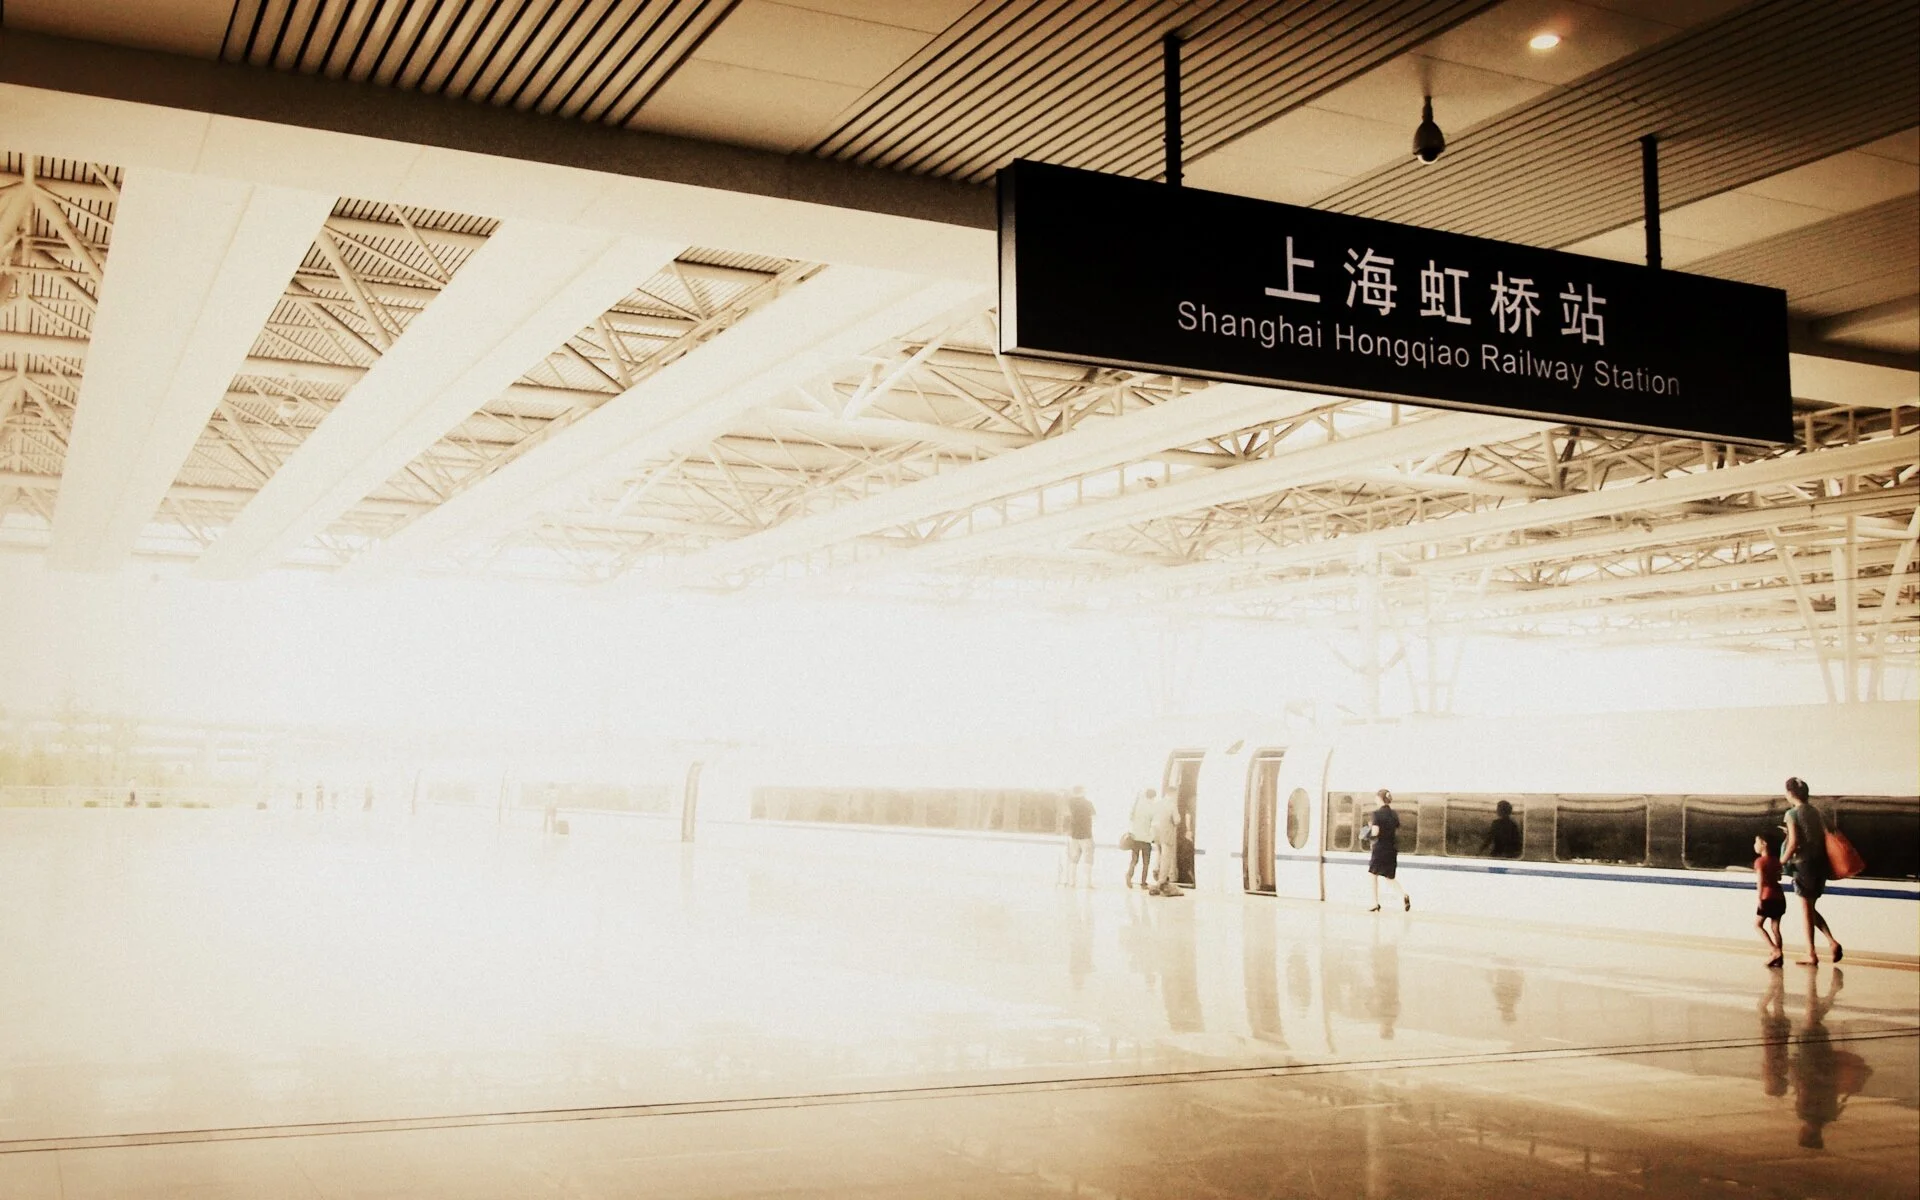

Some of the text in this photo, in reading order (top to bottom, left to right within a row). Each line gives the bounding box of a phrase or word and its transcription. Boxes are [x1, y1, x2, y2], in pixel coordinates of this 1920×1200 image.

[1264, 236, 1607, 346] 上海虹桥站
[1177, 300, 1680, 396] Shanghai Hongqiao Railway Station
